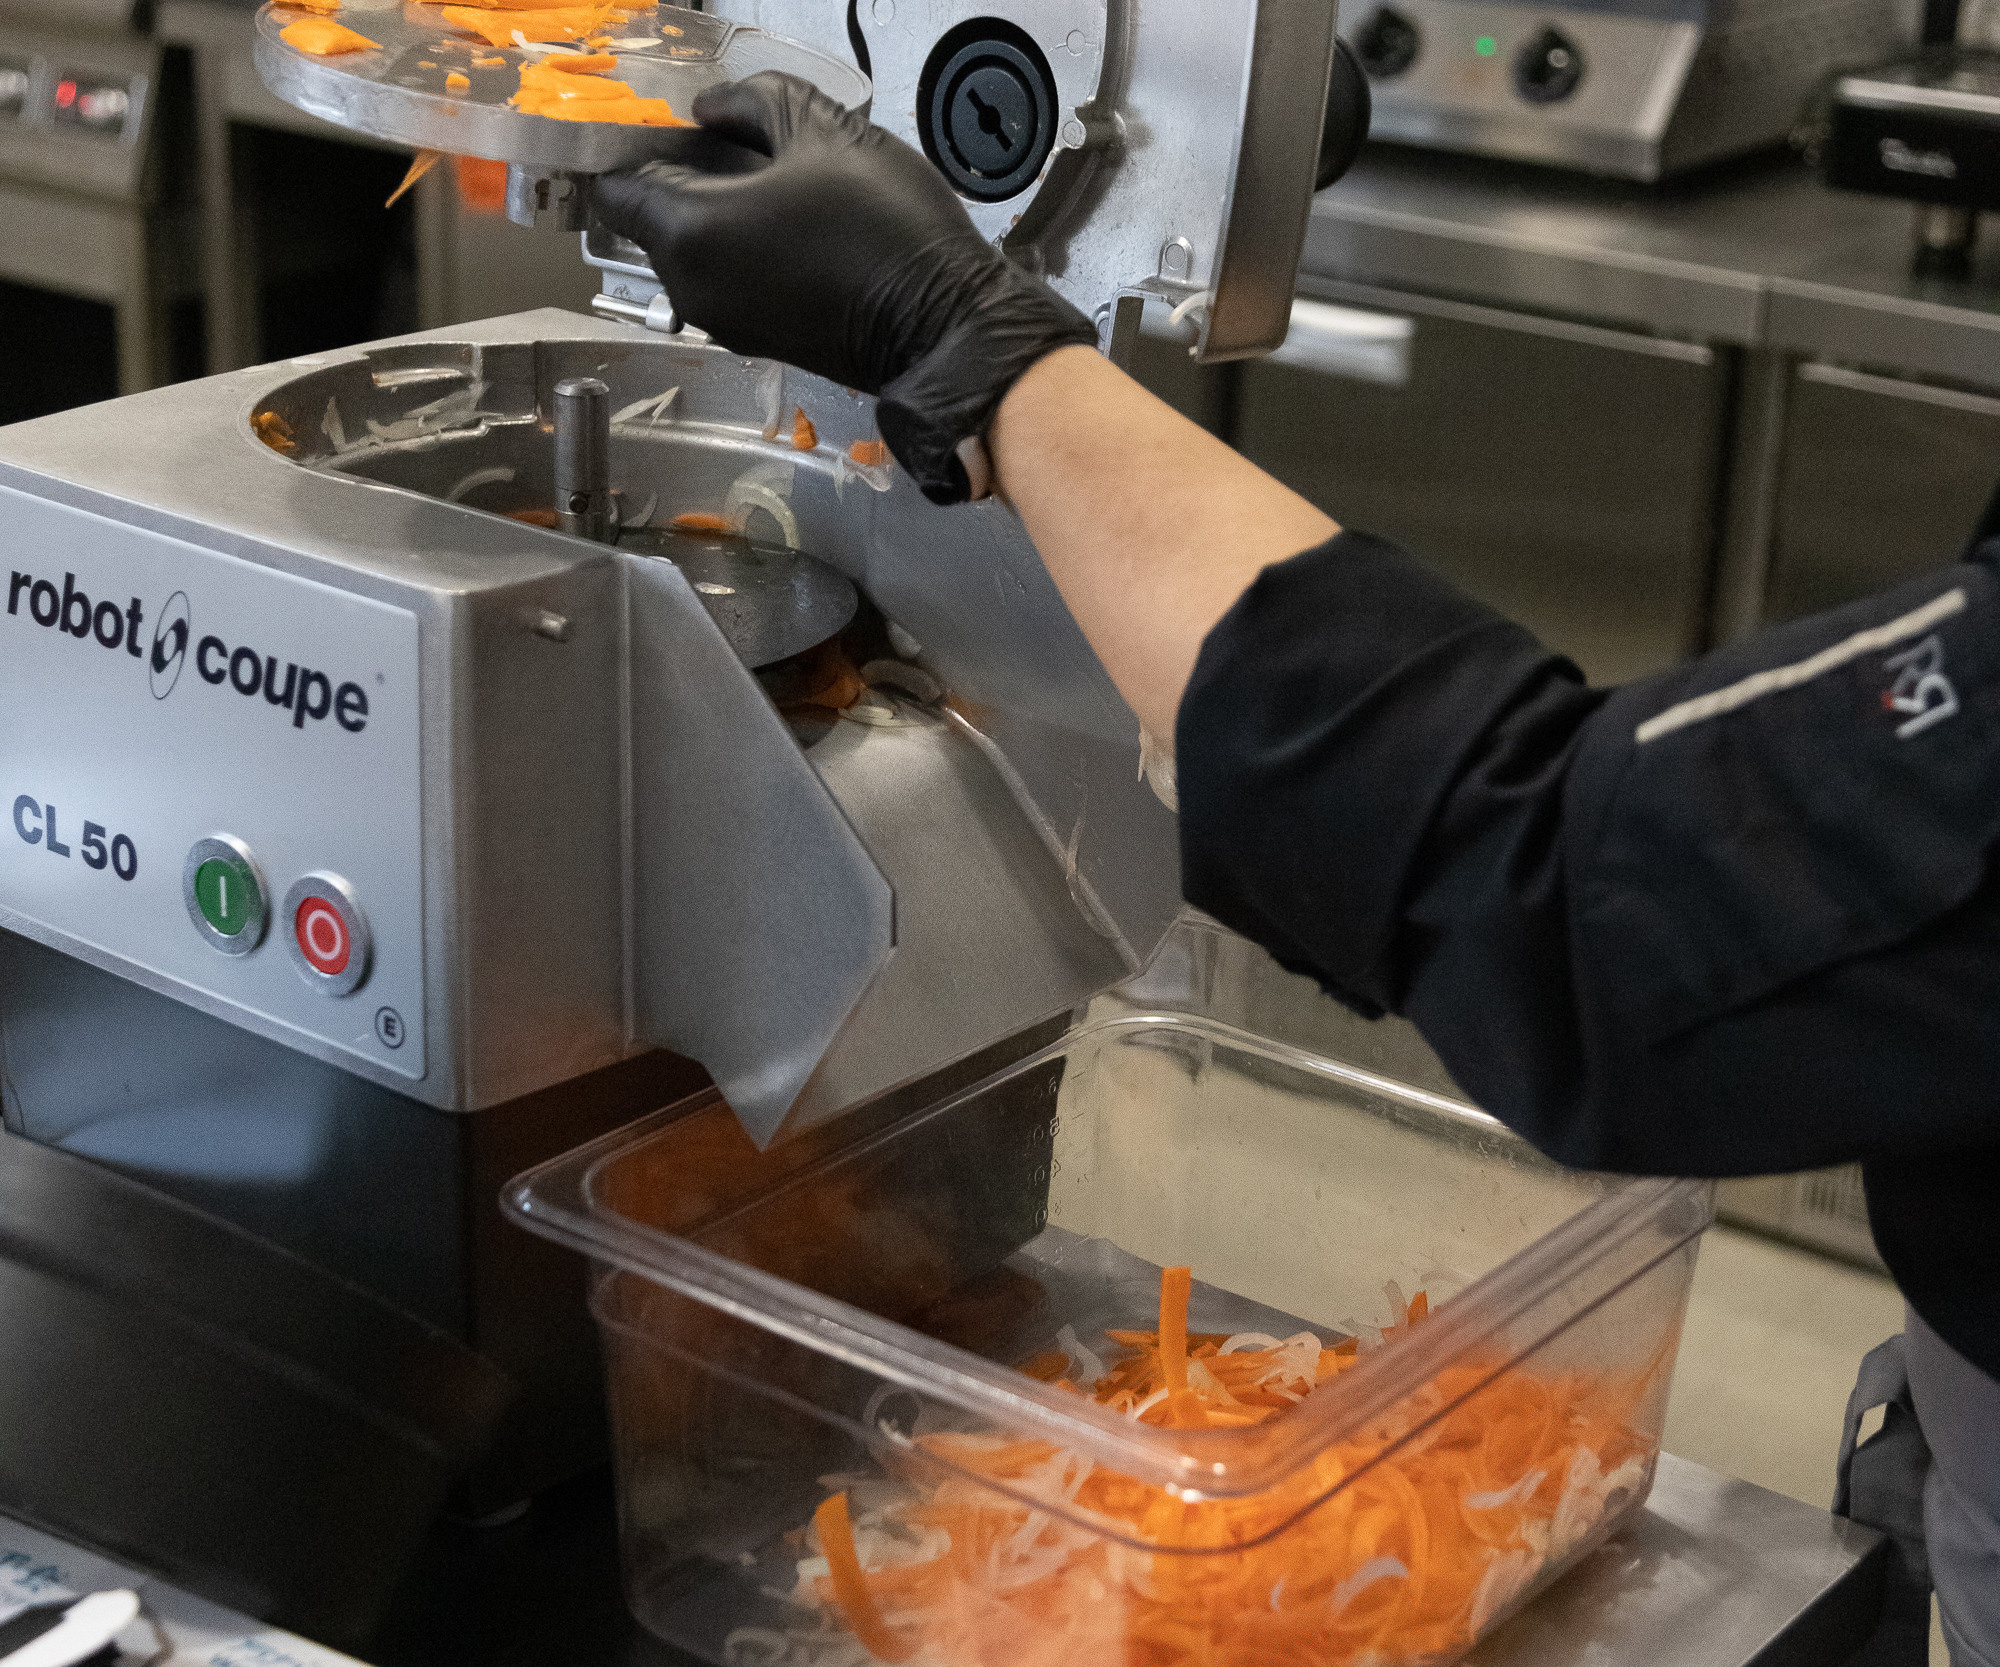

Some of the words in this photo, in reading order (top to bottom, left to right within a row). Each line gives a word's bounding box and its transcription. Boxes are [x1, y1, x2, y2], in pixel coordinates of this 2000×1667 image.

[7, 571, 143, 658] robot
[196, 635, 369, 732] coupe
[13, 794, 71, 858] CL
[81, 819, 138, 881] 50
